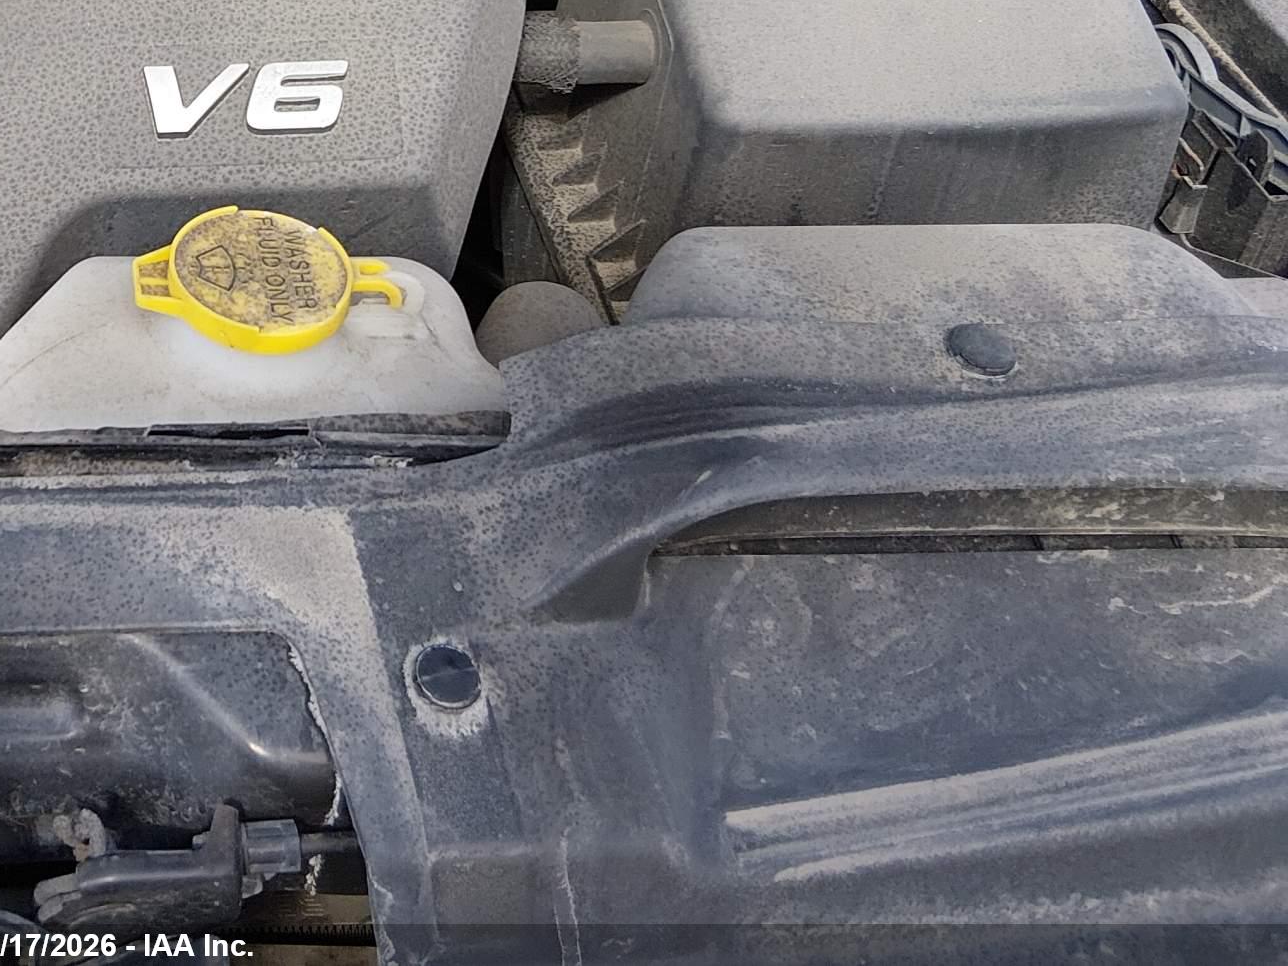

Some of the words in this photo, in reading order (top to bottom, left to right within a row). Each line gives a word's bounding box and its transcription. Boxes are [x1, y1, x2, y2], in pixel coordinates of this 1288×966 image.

[142, 60, 349, 140] V6
[253, 216, 281, 268] FLUID
[284, 229, 318, 309] WASHER
[265, 274, 296, 323] ONLY
